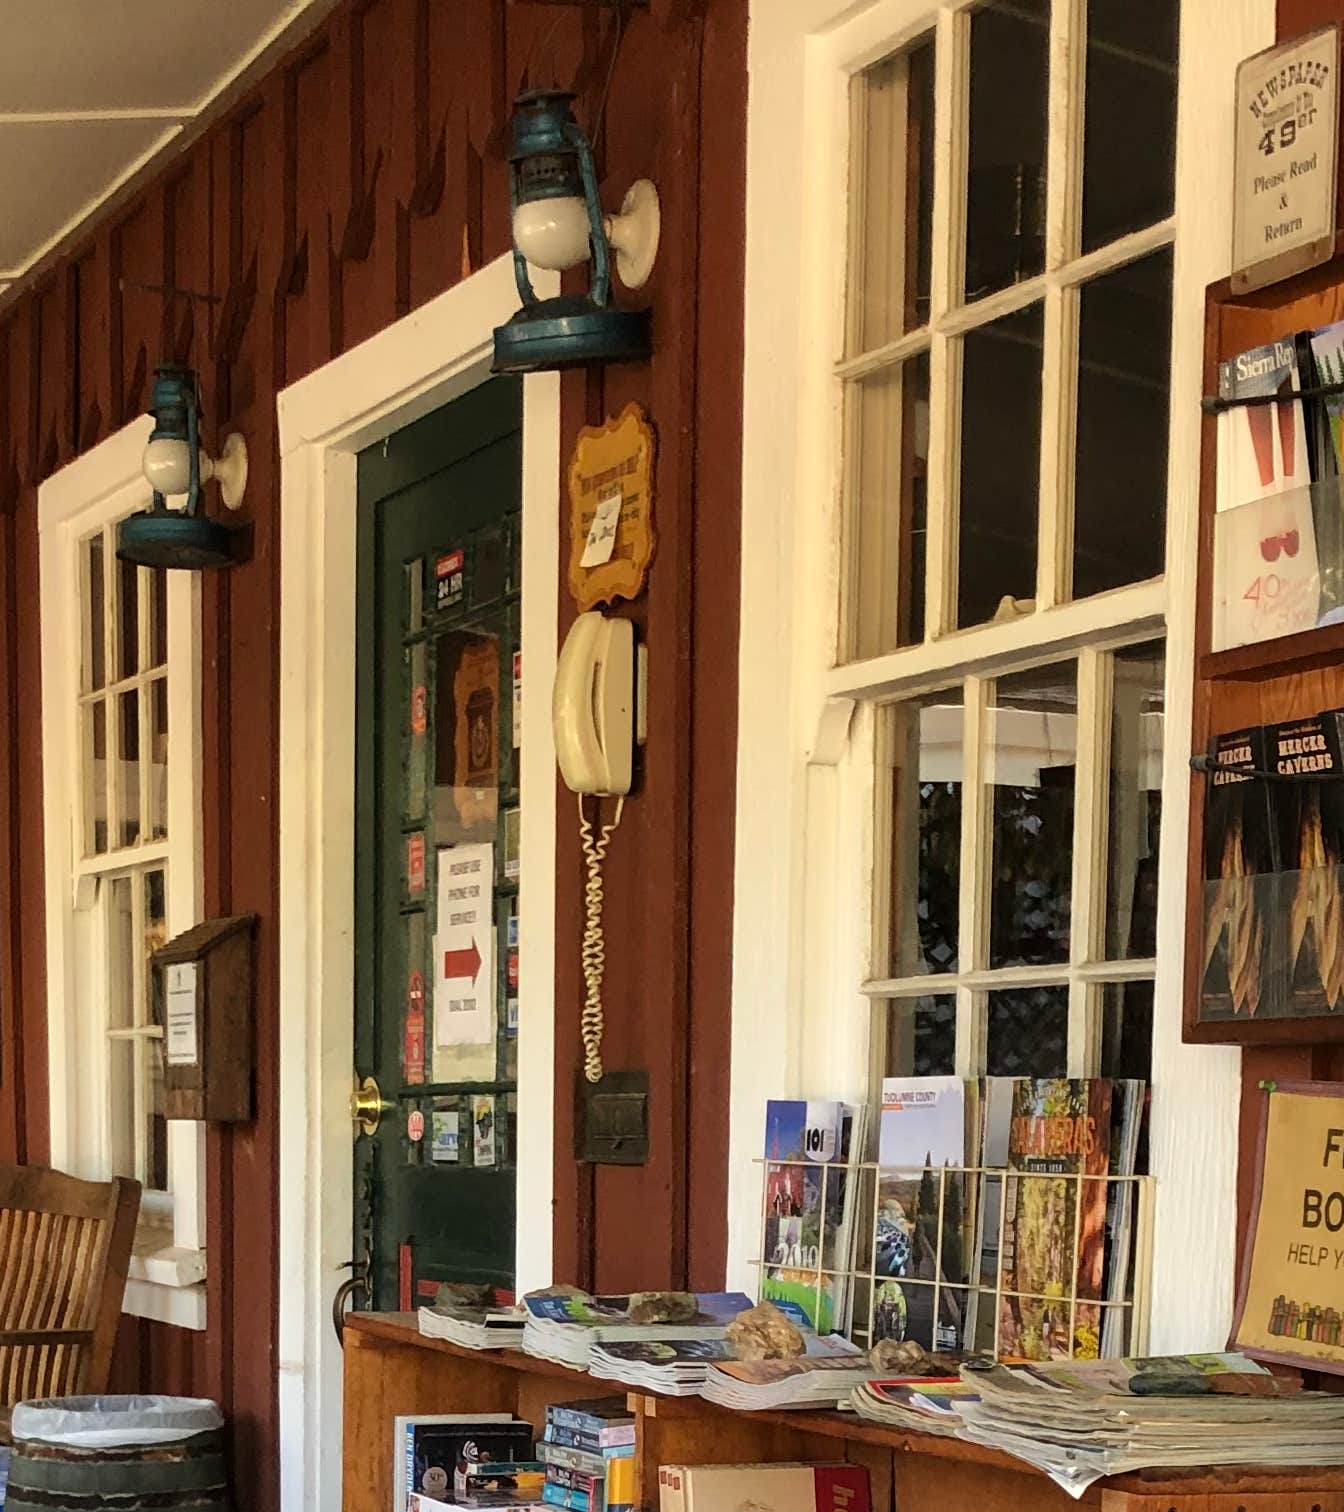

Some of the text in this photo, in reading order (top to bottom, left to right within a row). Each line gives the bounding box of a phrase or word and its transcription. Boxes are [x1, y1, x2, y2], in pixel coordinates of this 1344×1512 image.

[1253, 152, 1318, 195] Please Read
[1278, 192, 1290, 210] &
[1264, 216, 1303, 243] Return
[1236, 354, 1275, 380] Sierra
[1278, 734, 1327, 757] MERCER
[1277, 753, 1333, 776] CAVERNS
[1287, 1242, 1329, 1268] HELP
